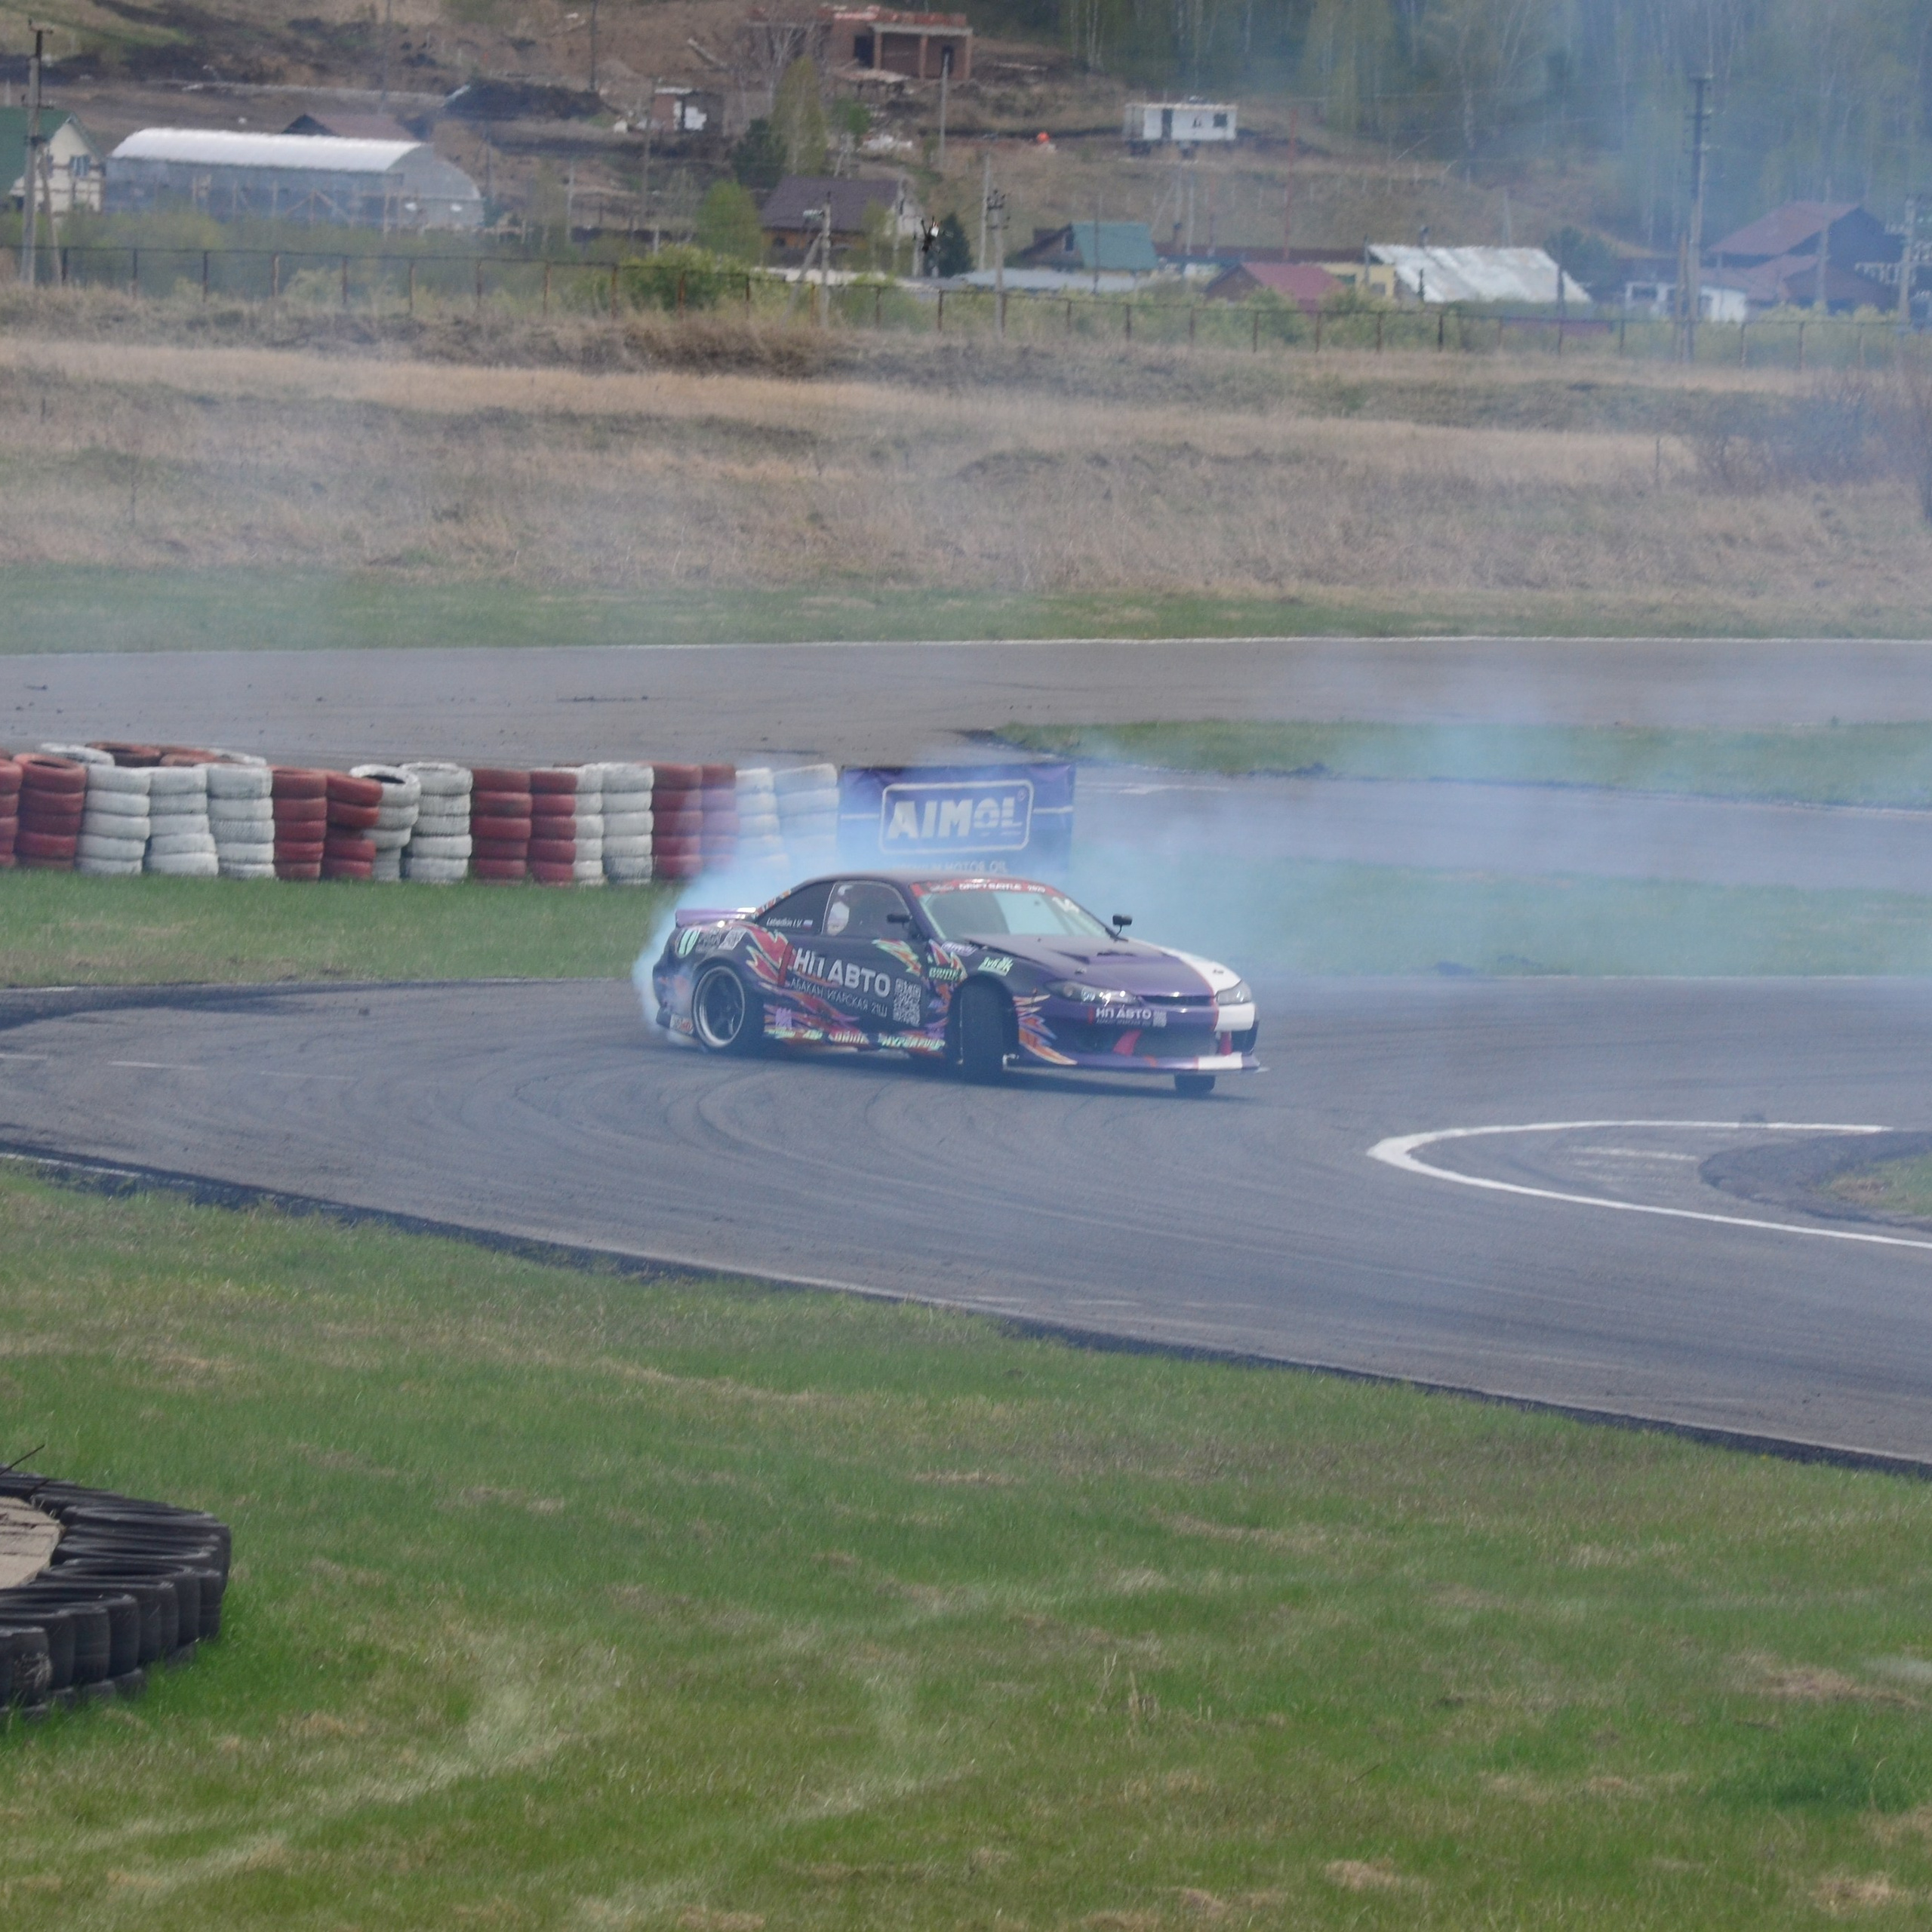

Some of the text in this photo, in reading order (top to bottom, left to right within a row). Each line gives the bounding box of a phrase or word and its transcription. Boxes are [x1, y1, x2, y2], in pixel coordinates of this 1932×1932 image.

[885, 796, 1023, 839] AIMOL
[827, 959, 891, 998] АВТО
[1116, 1008, 1152, 1020] АВТО
